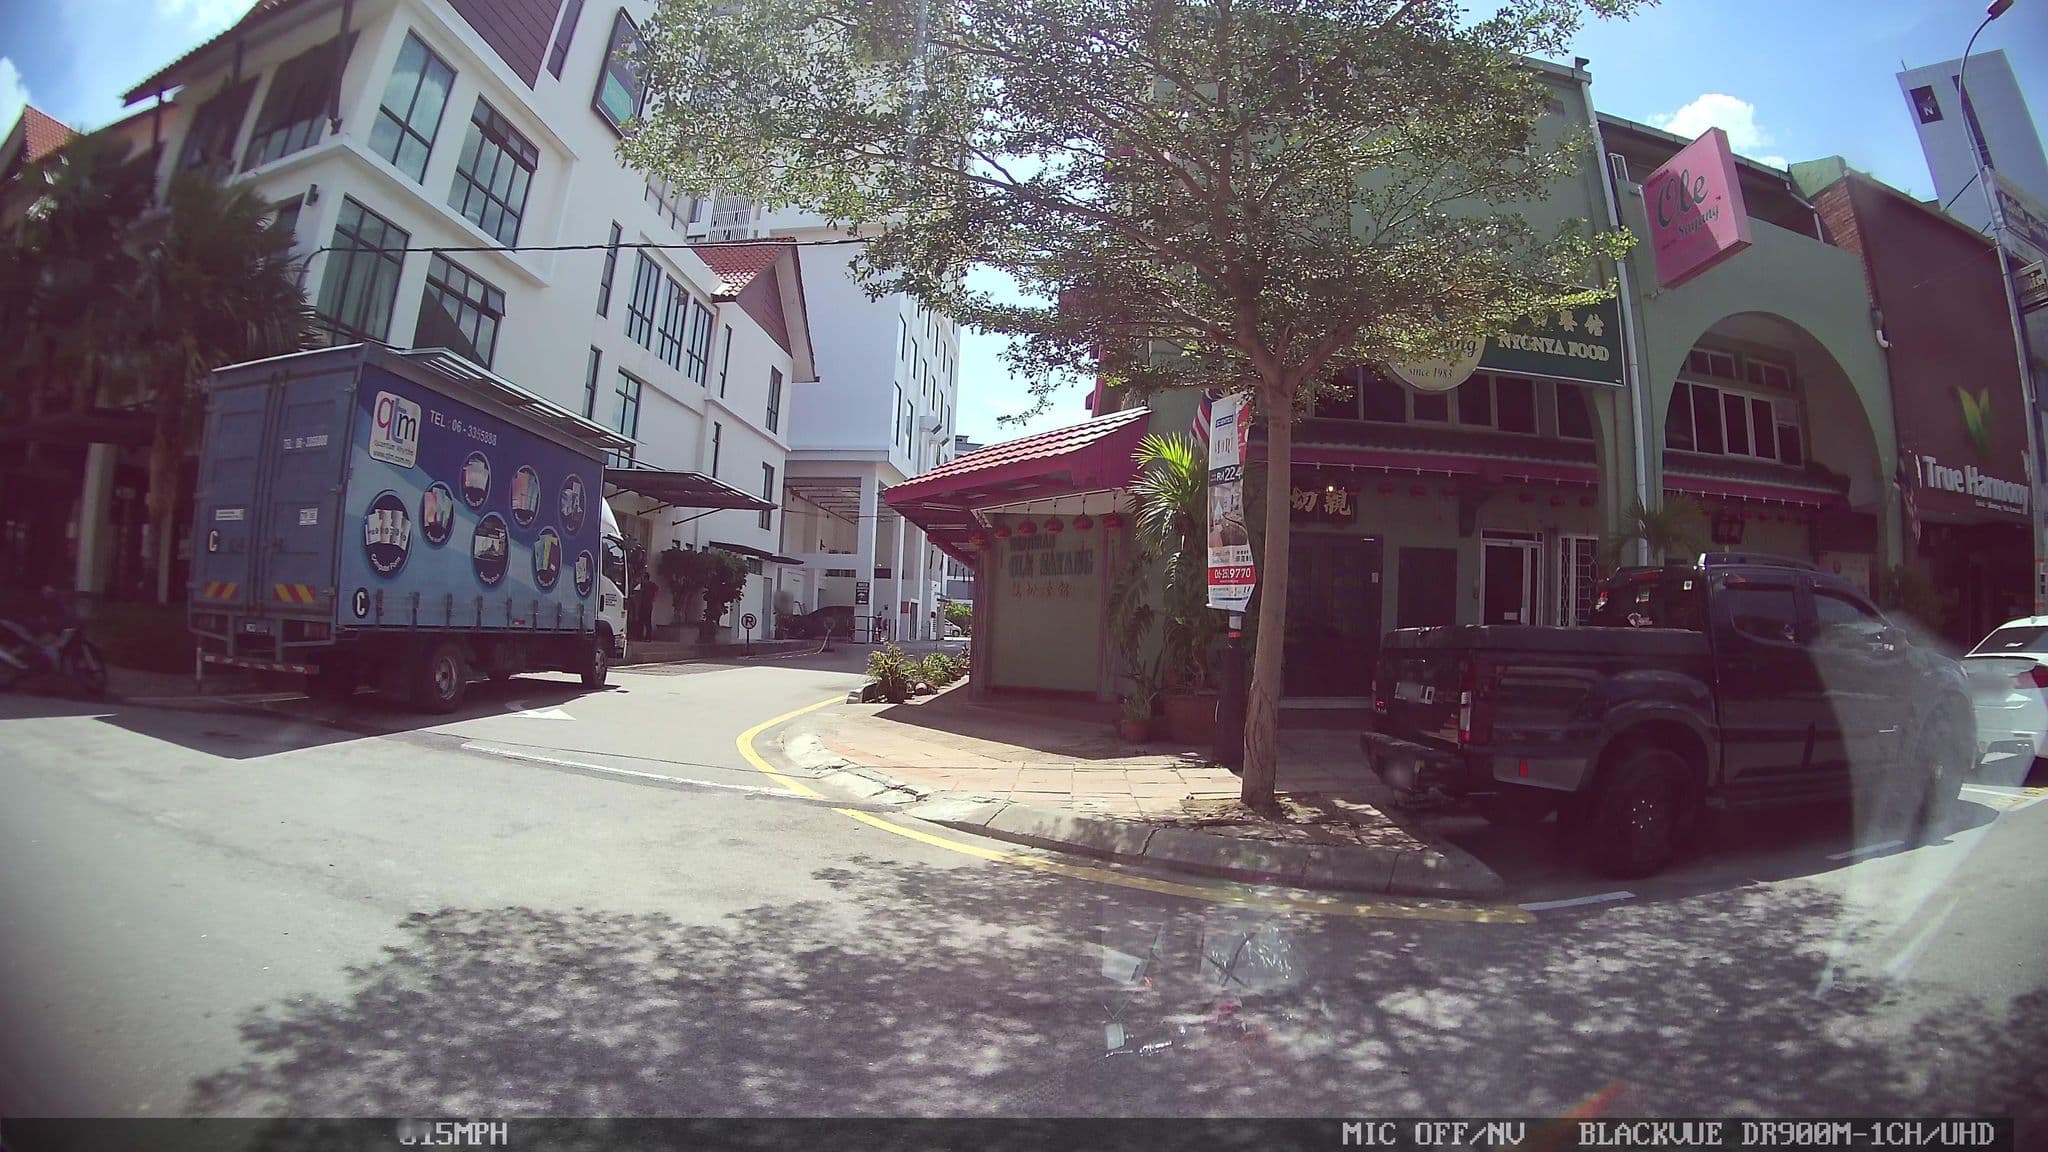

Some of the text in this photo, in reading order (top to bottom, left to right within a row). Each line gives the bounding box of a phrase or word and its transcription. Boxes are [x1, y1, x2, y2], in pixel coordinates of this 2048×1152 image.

[1567, 340, 1610, 363] FOOD
[1922, 455, 2029, 515] True Harmony
[208, 530, 218, 552] C
[356, 591, 366, 616] C
